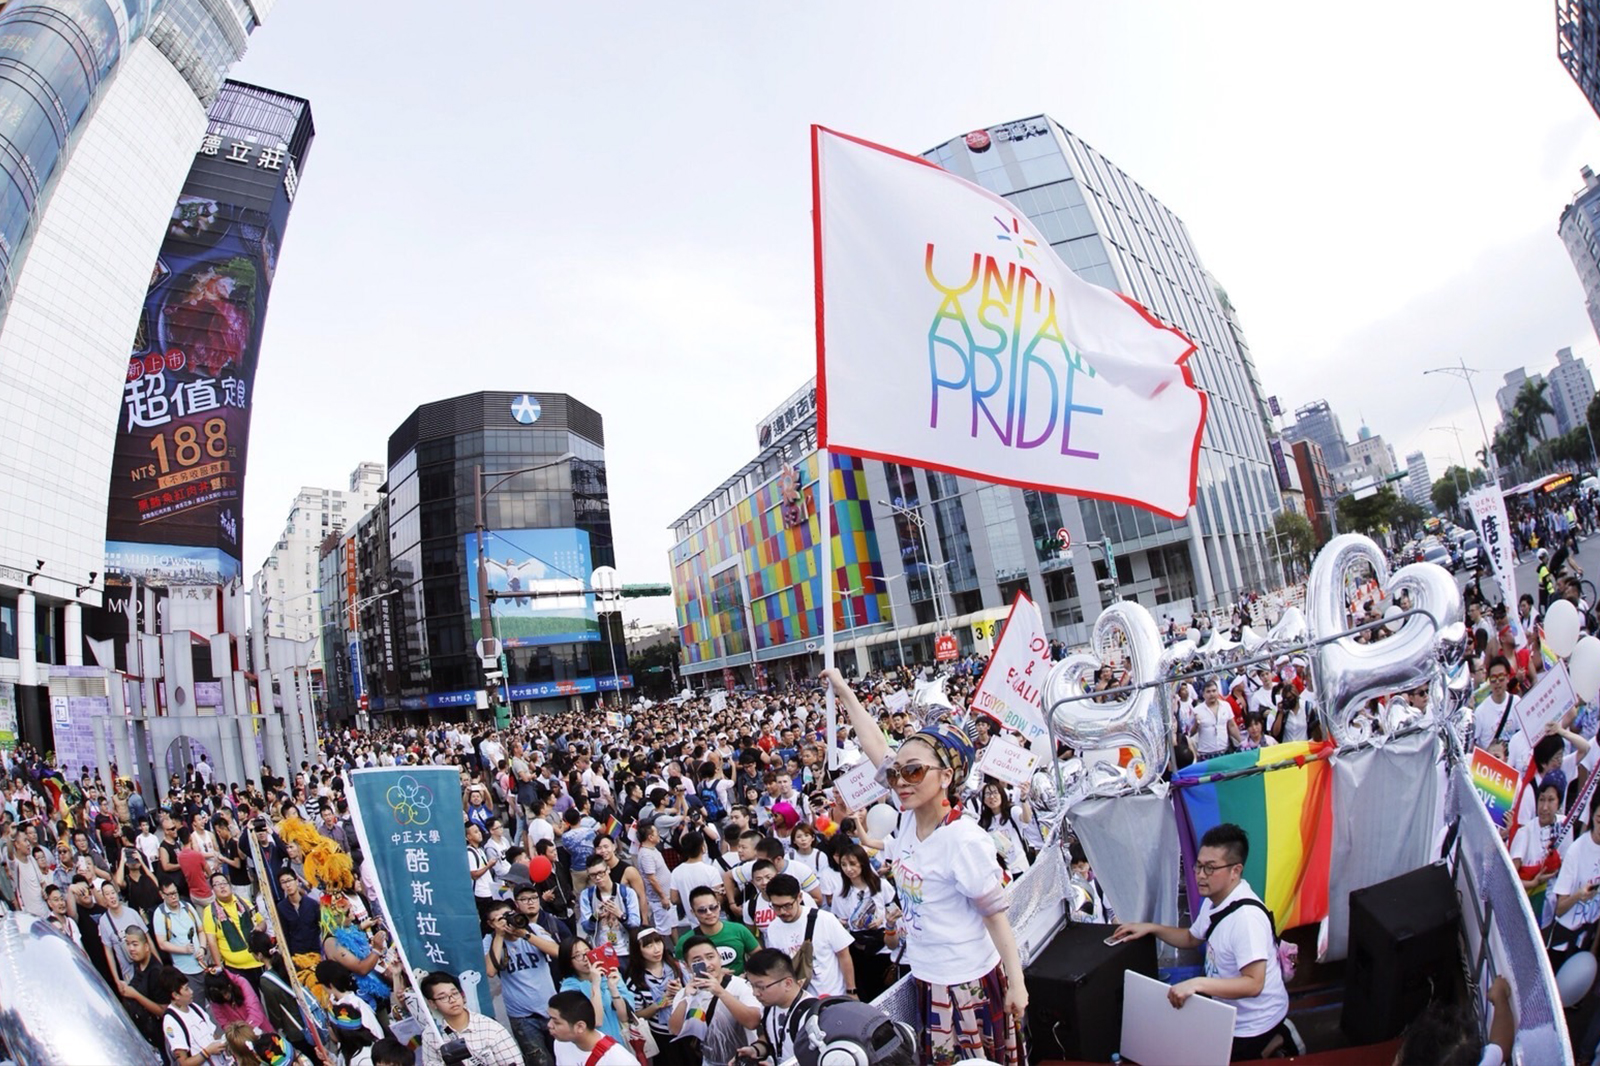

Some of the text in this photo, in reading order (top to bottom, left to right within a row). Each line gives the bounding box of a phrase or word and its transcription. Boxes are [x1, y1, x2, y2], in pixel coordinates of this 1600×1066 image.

[128, 350, 185, 381] 新上市
[928, 335, 1104, 460] PRIDE
[130, 417, 229, 482] NT$ 188
[975, 627, 984, 641] 3
[335, 650, 345, 688] AIGLE
[1024, 660, 1036, 677] &
[1003, 748, 1022, 760] LOVE
[992, 757, 1022, 775] EQUALITY
[849, 772, 865, 785] LOVE
[1475, 761, 1514, 793] LOVE IS
[851, 780, 878, 800] EQUALITY
[391, 829, 441, 846] 中正大學
[404, 847, 449, 965] 酷斯拉社
[506, 952, 540, 975] GAP
[721, 951, 734, 961] ile
